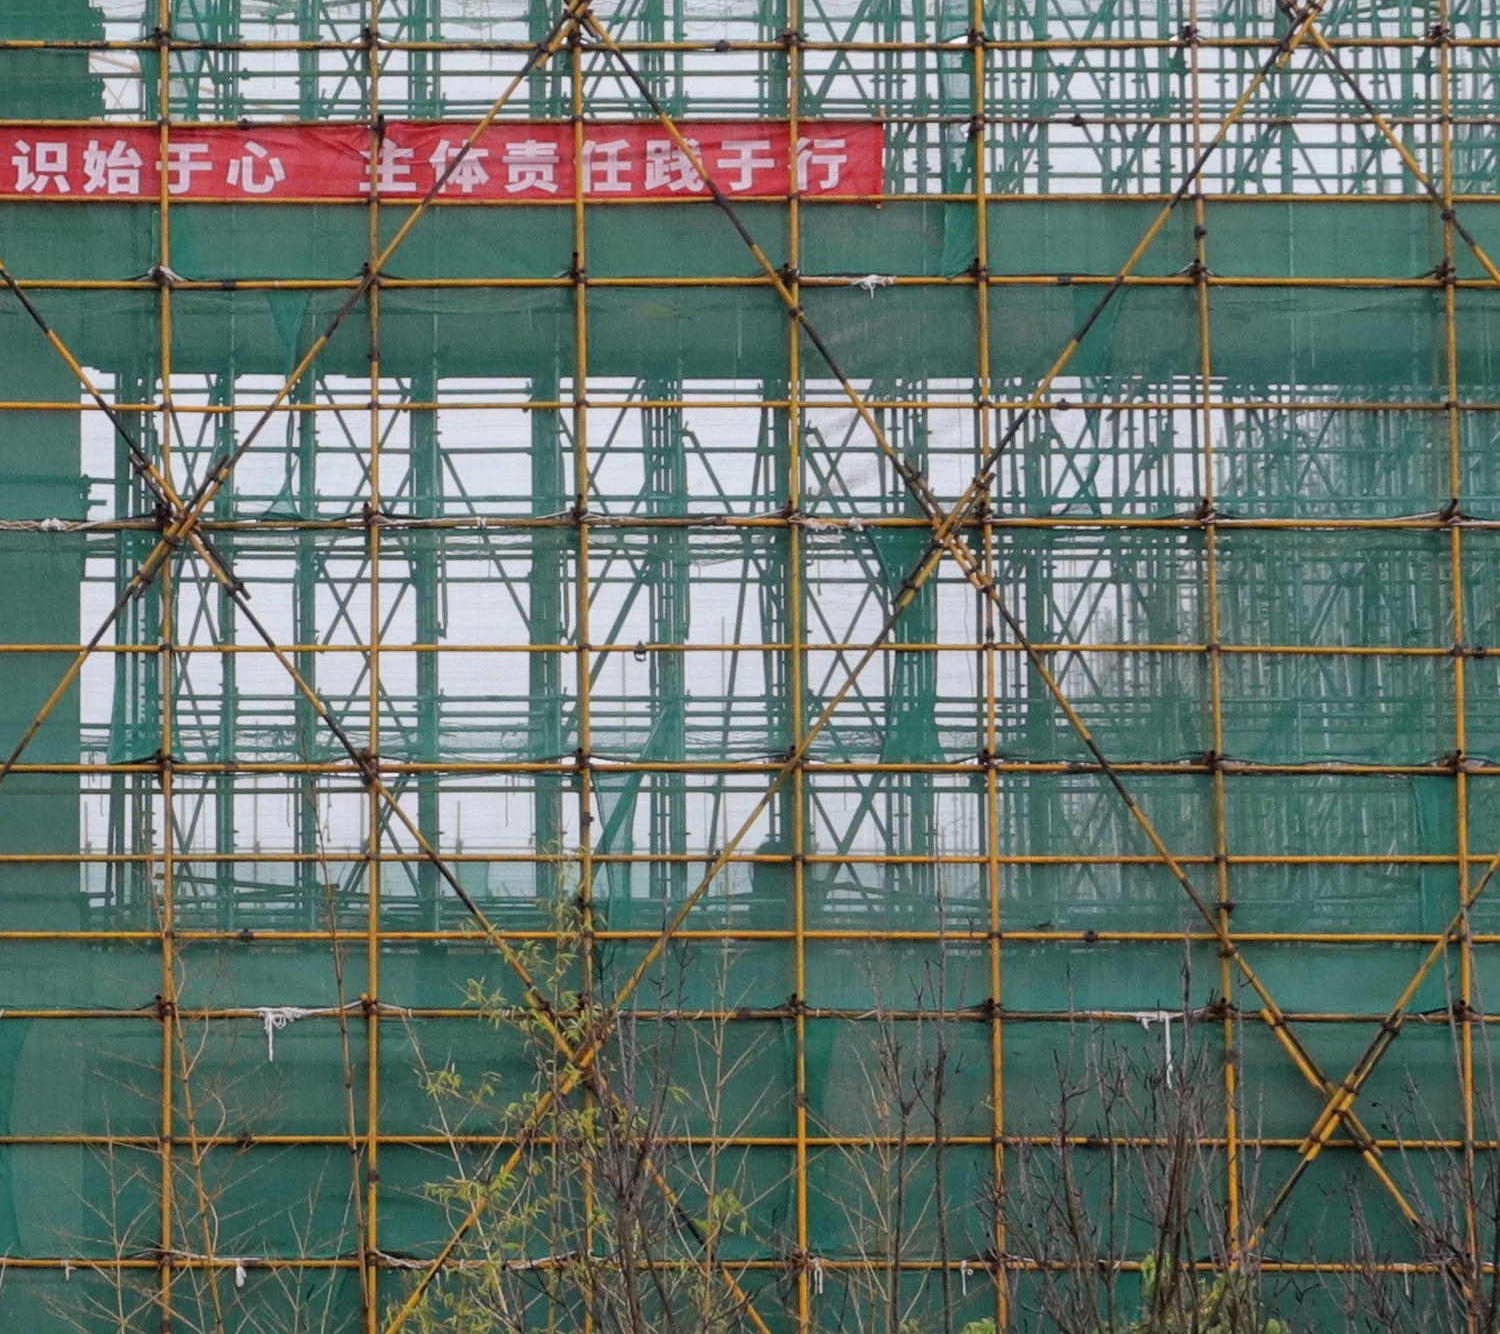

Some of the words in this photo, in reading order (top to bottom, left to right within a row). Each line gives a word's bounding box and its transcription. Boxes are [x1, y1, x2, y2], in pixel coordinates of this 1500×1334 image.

[359, 137, 848, 194] 主体责任践于行
